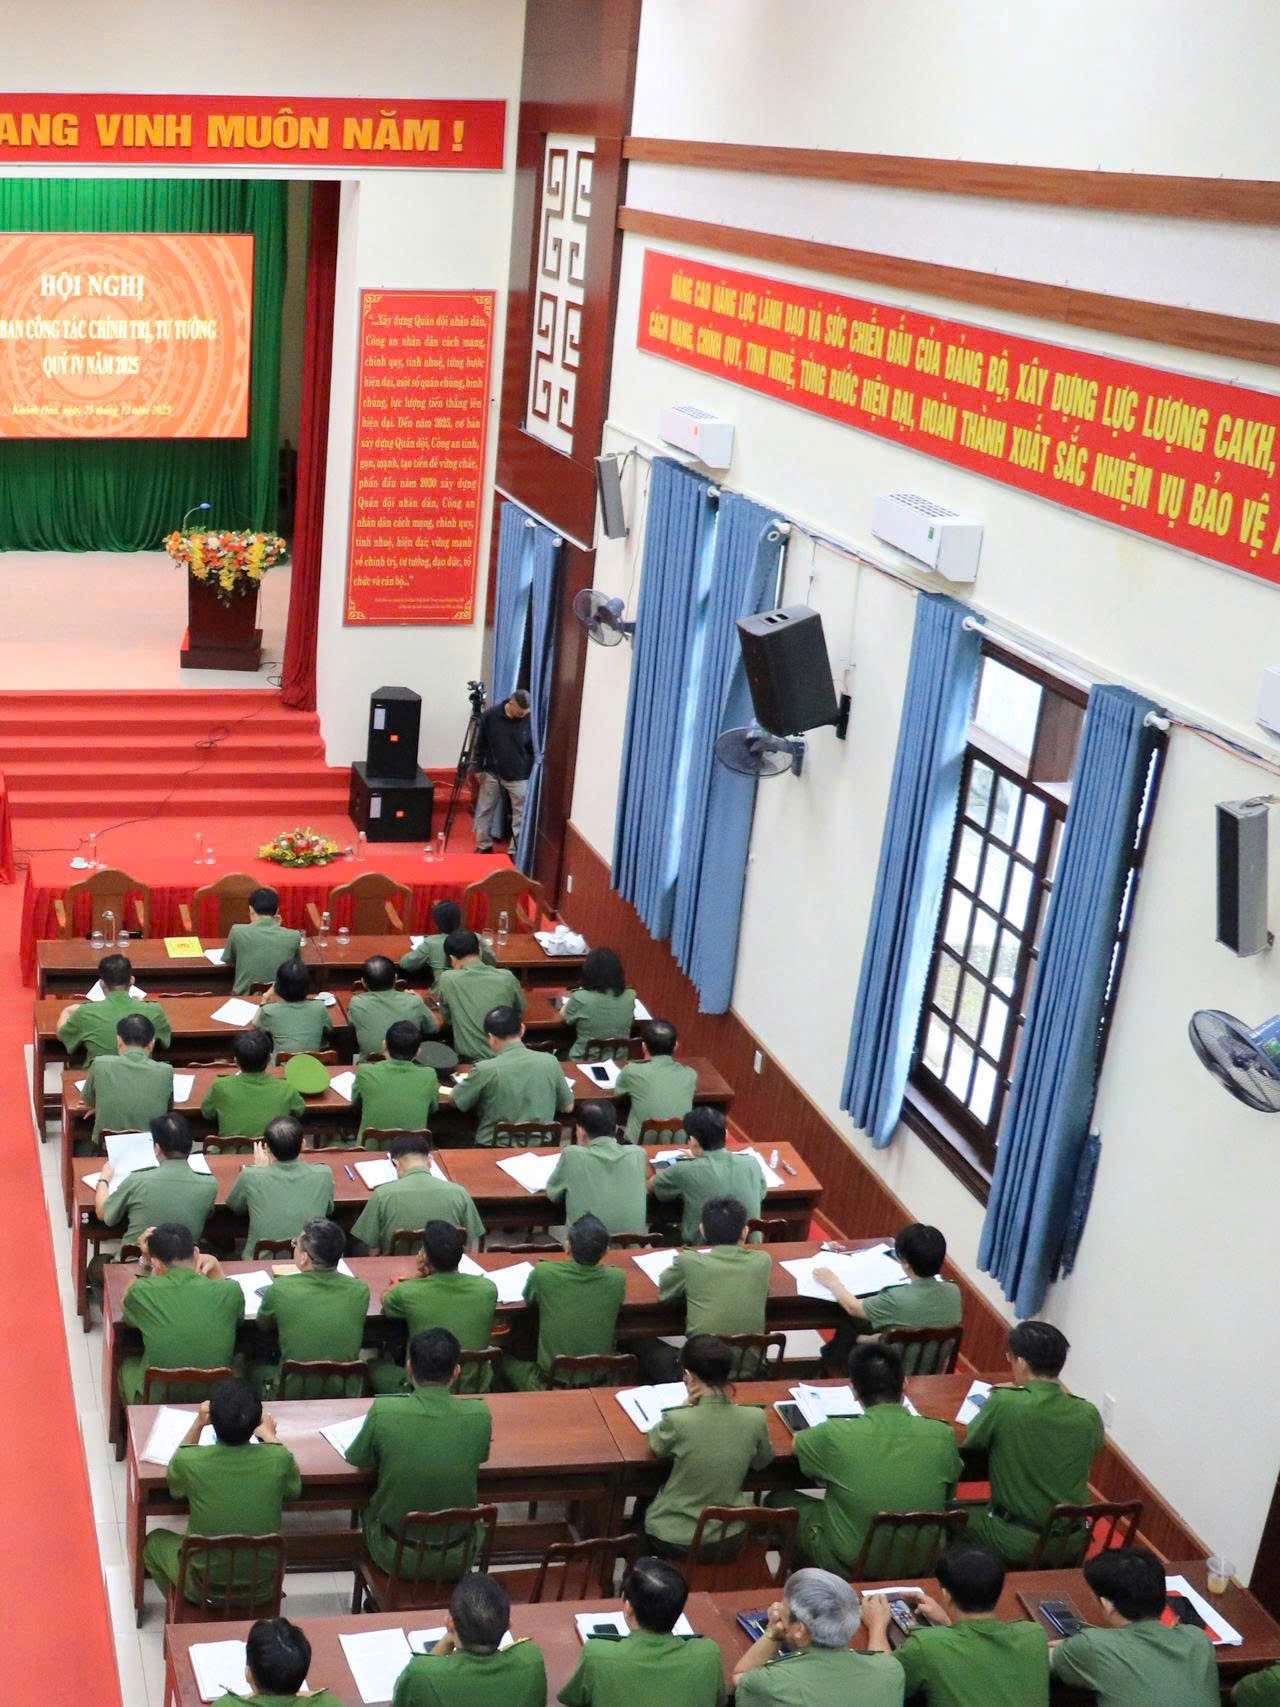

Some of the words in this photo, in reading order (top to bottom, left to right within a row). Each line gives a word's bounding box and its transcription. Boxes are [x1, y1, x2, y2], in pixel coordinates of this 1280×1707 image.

[95, 114, 191, 147] VINH
[207, 108, 328, 148] MUÔN
[342, 110, 439, 151] NĂM
[40, 273, 80, 301] HỘI
[88, 274, 144, 302] NGHỊ
[672, 269, 692, 304] NÂNG
[694, 280, 711, 309] CAO
[713, 281, 737, 317] NĂNG
[738, 291, 755, 326] LỰC
[758, 290, 783, 330] LÃNH
[785, 304, 805, 341] ĐẠO
[808, 302, 821, 341] VÀ
[825, 306, 847, 348] SỨC
[850, 308, 884, 359] CHIẾN
[887, 314, 913, 367] ĐẤU
[915, 326, 941, 376] CỦA
[945, 334, 983, 388] ĐẢNG
[986, 350, 1009, 403] BỘ,
[1015, 357, 1049, 406] XÂY
[1051, 372, 1098, 423] DỰNG
[1102, 385, 1138, 437] LỰC
[1142, 396, 1209, 453] LƯỢNG
[1214, 414, 1275, 479] CAKH,
[746, 342, 768, 375] TINH
[800, 352, 827, 395] TỪNG
[829, 364, 858, 407] BƯỚC
[860, 374, 889, 421] HIỆN
[891, 388, 914, 432] ĐẠI,
[920, 392, 957, 442] HOÀN
[960, 404, 1007, 458] THÀNH
[1009, 414, 1051, 473] XUẤT
[1053, 426, 1088, 487] SẮC
[1091, 453, 1153, 511] NHIỆM
[1158, 473, 1185, 528] VỤ
[1188, 472, 1233, 536] BẢO
[1240, 493, 1269, 557] VỆ
